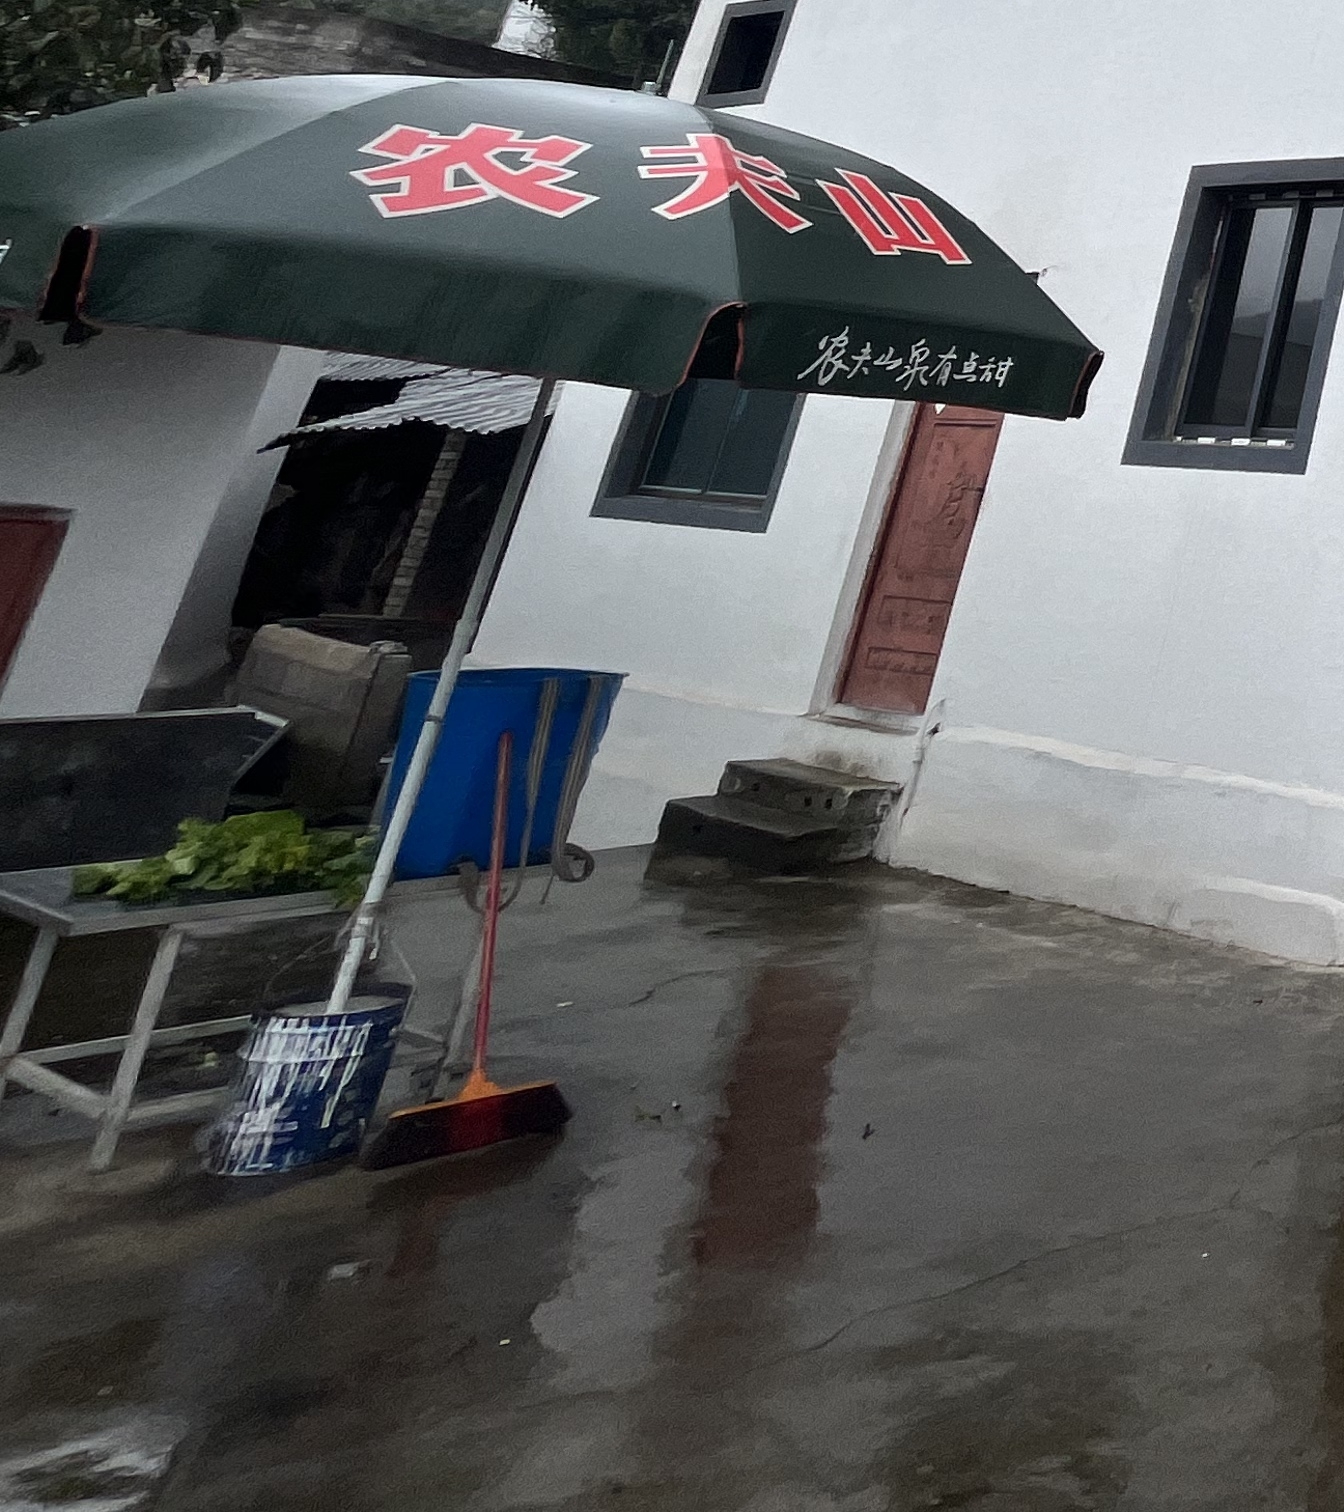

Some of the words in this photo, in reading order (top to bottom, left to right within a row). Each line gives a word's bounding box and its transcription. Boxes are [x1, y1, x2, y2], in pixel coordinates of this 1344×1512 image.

[350, 122, 972, 265] 农夫山
[797, 326, 1014, 391] 农夫山泉有点甜
